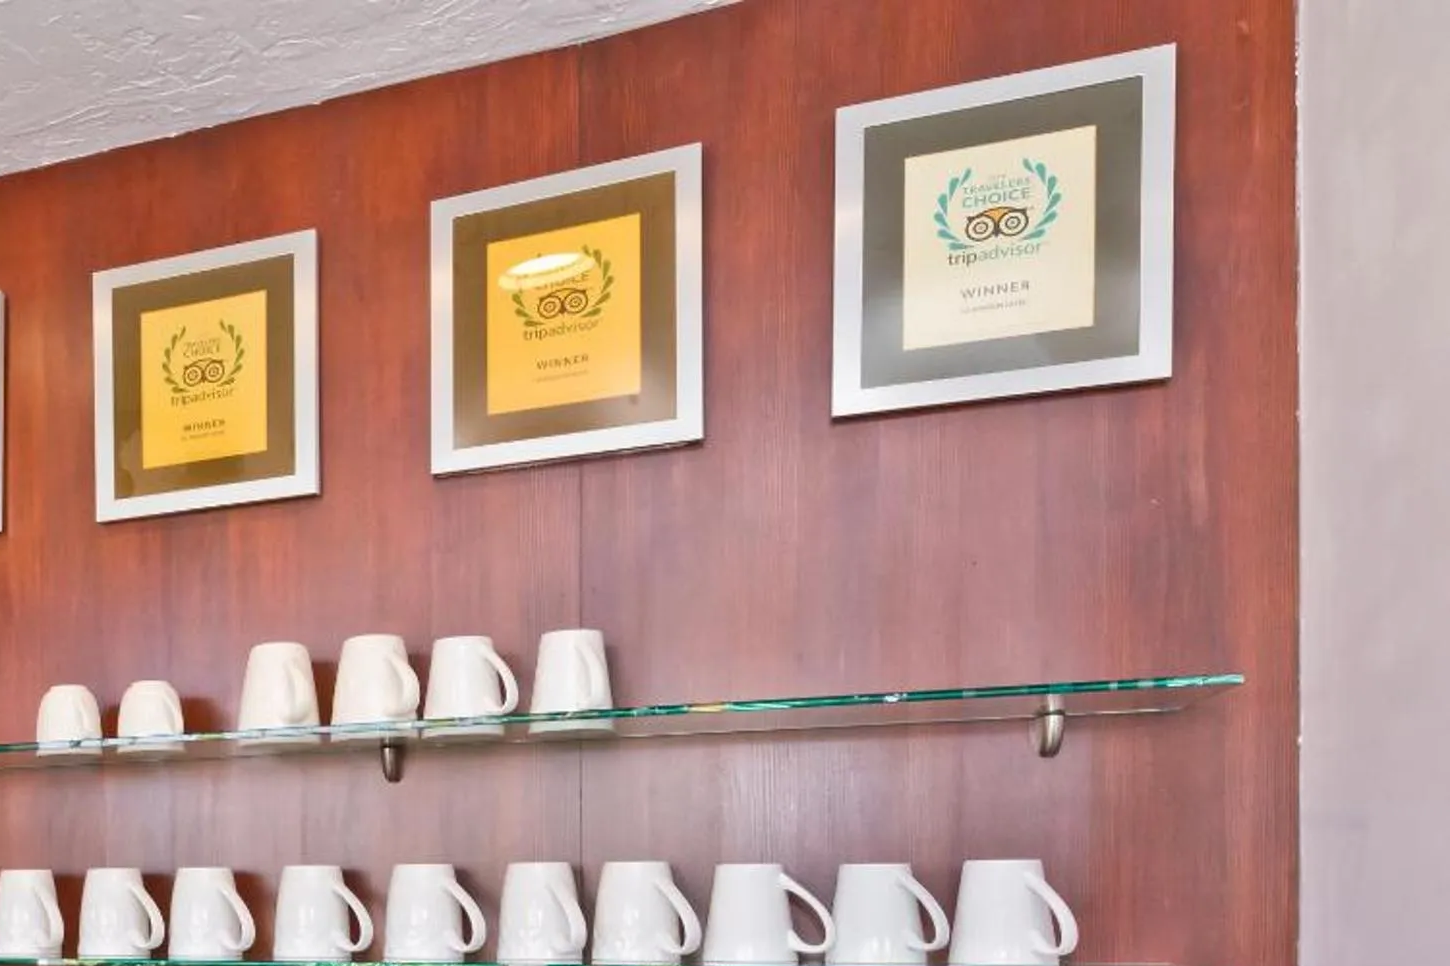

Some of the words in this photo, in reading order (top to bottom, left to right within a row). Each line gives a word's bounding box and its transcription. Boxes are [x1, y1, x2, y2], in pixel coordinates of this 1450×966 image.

[962, 187, 1031, 208] CHOICE
[947, 242, 1042, 267] tripadvisor
[960, 280, 1030, 299] WINNER
[523, 319, 599, 341] tripadvisor
[535, 353, 589, 370] WINNER
